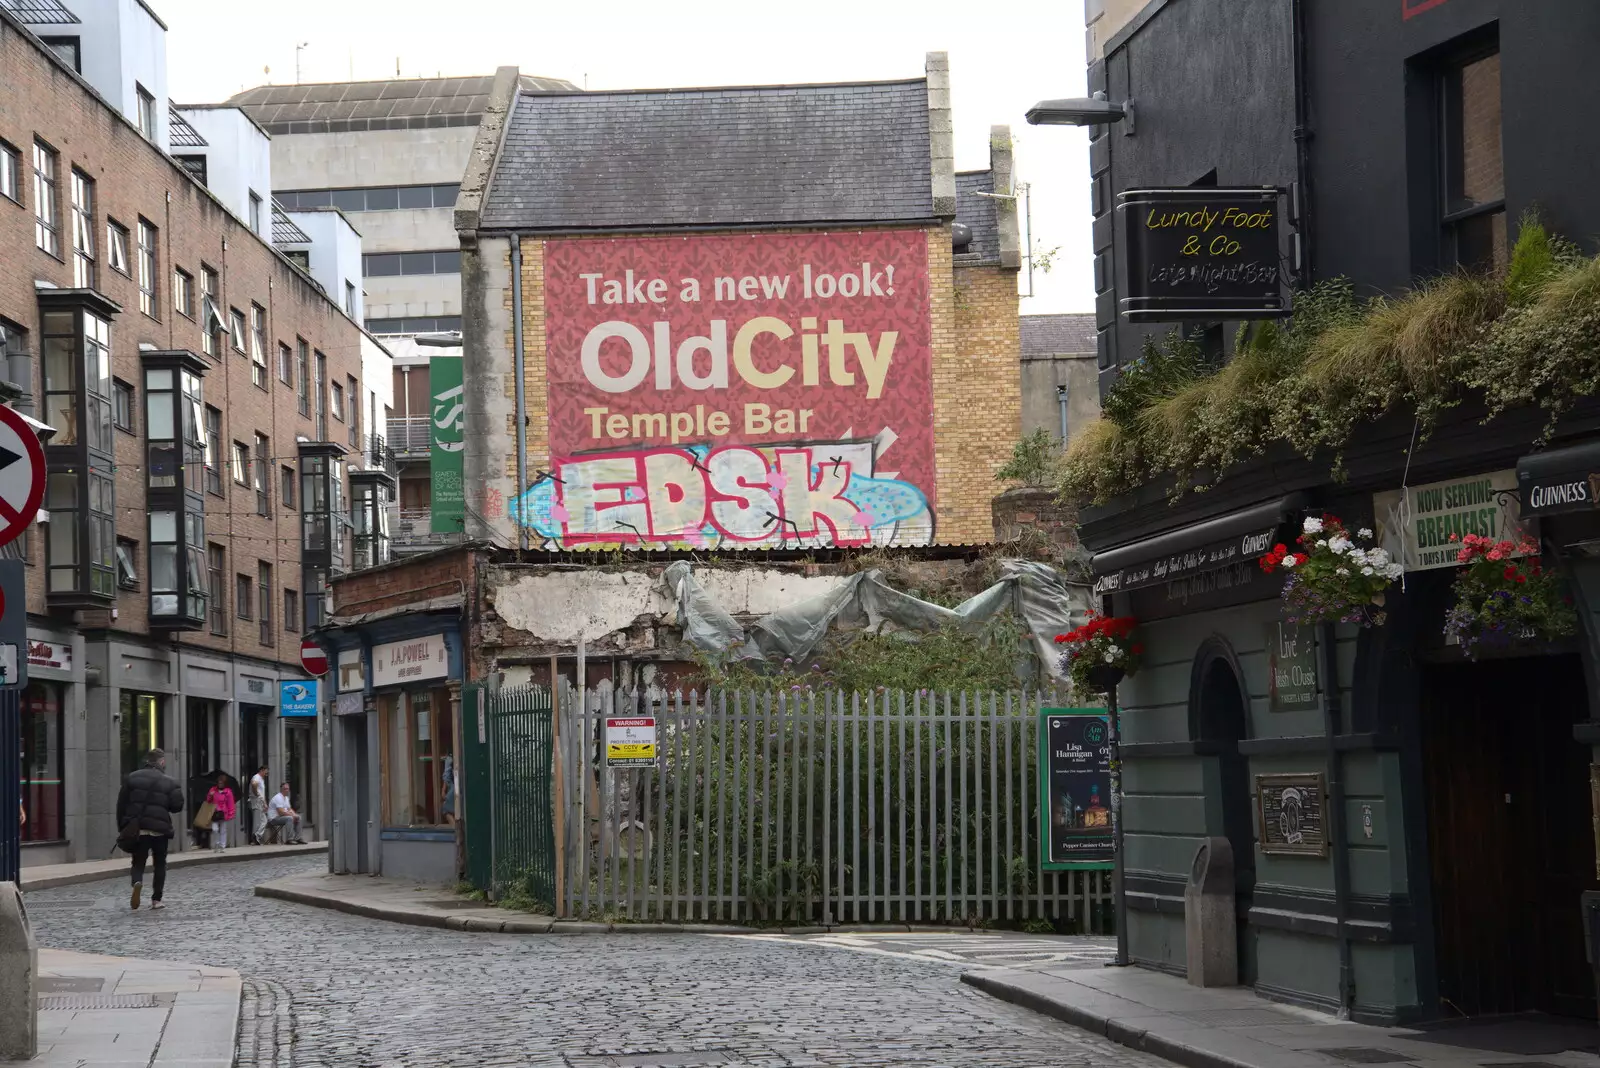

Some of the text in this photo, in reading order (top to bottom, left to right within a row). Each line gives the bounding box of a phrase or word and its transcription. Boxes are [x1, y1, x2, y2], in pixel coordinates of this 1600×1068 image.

[1146, 206, 1272, 232] Lundy Foot
[1181, 235, 1240, 256] & Co
[580, 262, 896, 304] Take a new look!
[580, 316, 898, 399] OldCity
[584, 402, 814, 444] Temple Bar
[1417, 480, 1493, 514] NOW SERVING
[1530, 482, 1586, 508] GUINNESS
[1416, 508, 1496, 548] BREAKFAST
[1242, 534, 1269, 554] GUINNESS
[1424, 550, 1440, 565] DAYS
[1441, 550, 1445, 564] A
[1278, 622, 1298, 658] Live
[1056, 750, 1092, 758] Hannigan
